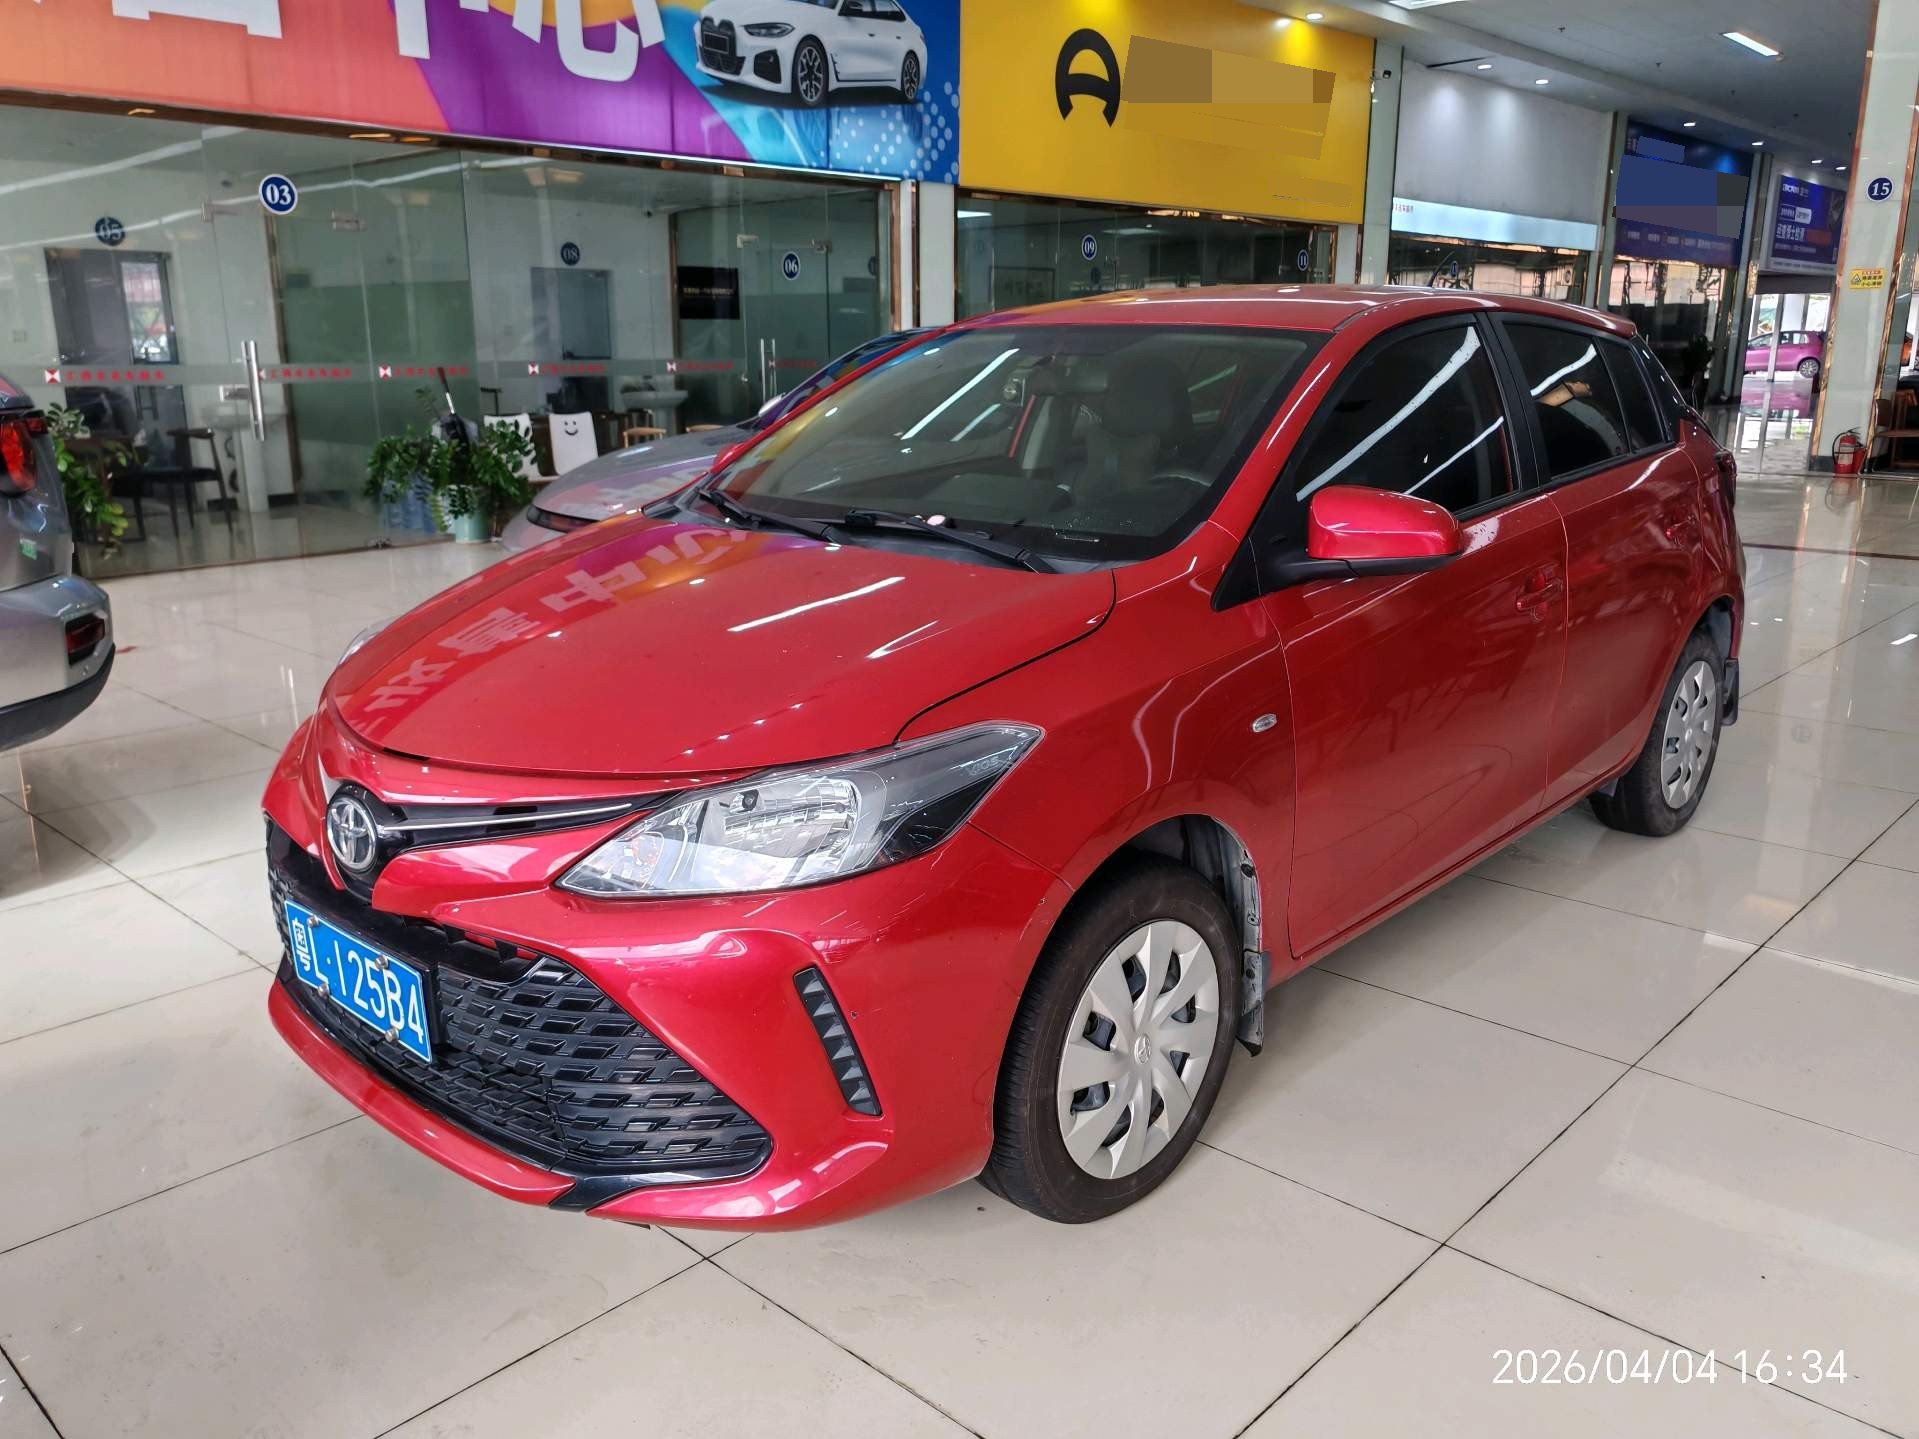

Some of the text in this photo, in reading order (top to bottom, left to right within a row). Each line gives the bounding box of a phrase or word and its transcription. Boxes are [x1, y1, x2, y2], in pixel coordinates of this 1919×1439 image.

[266, 183, 291, 205] 03
[1871, 182, 1890, 196] 15
[1084, 240, 1095, 254] 09
[784, 258, 798, 273] 06
